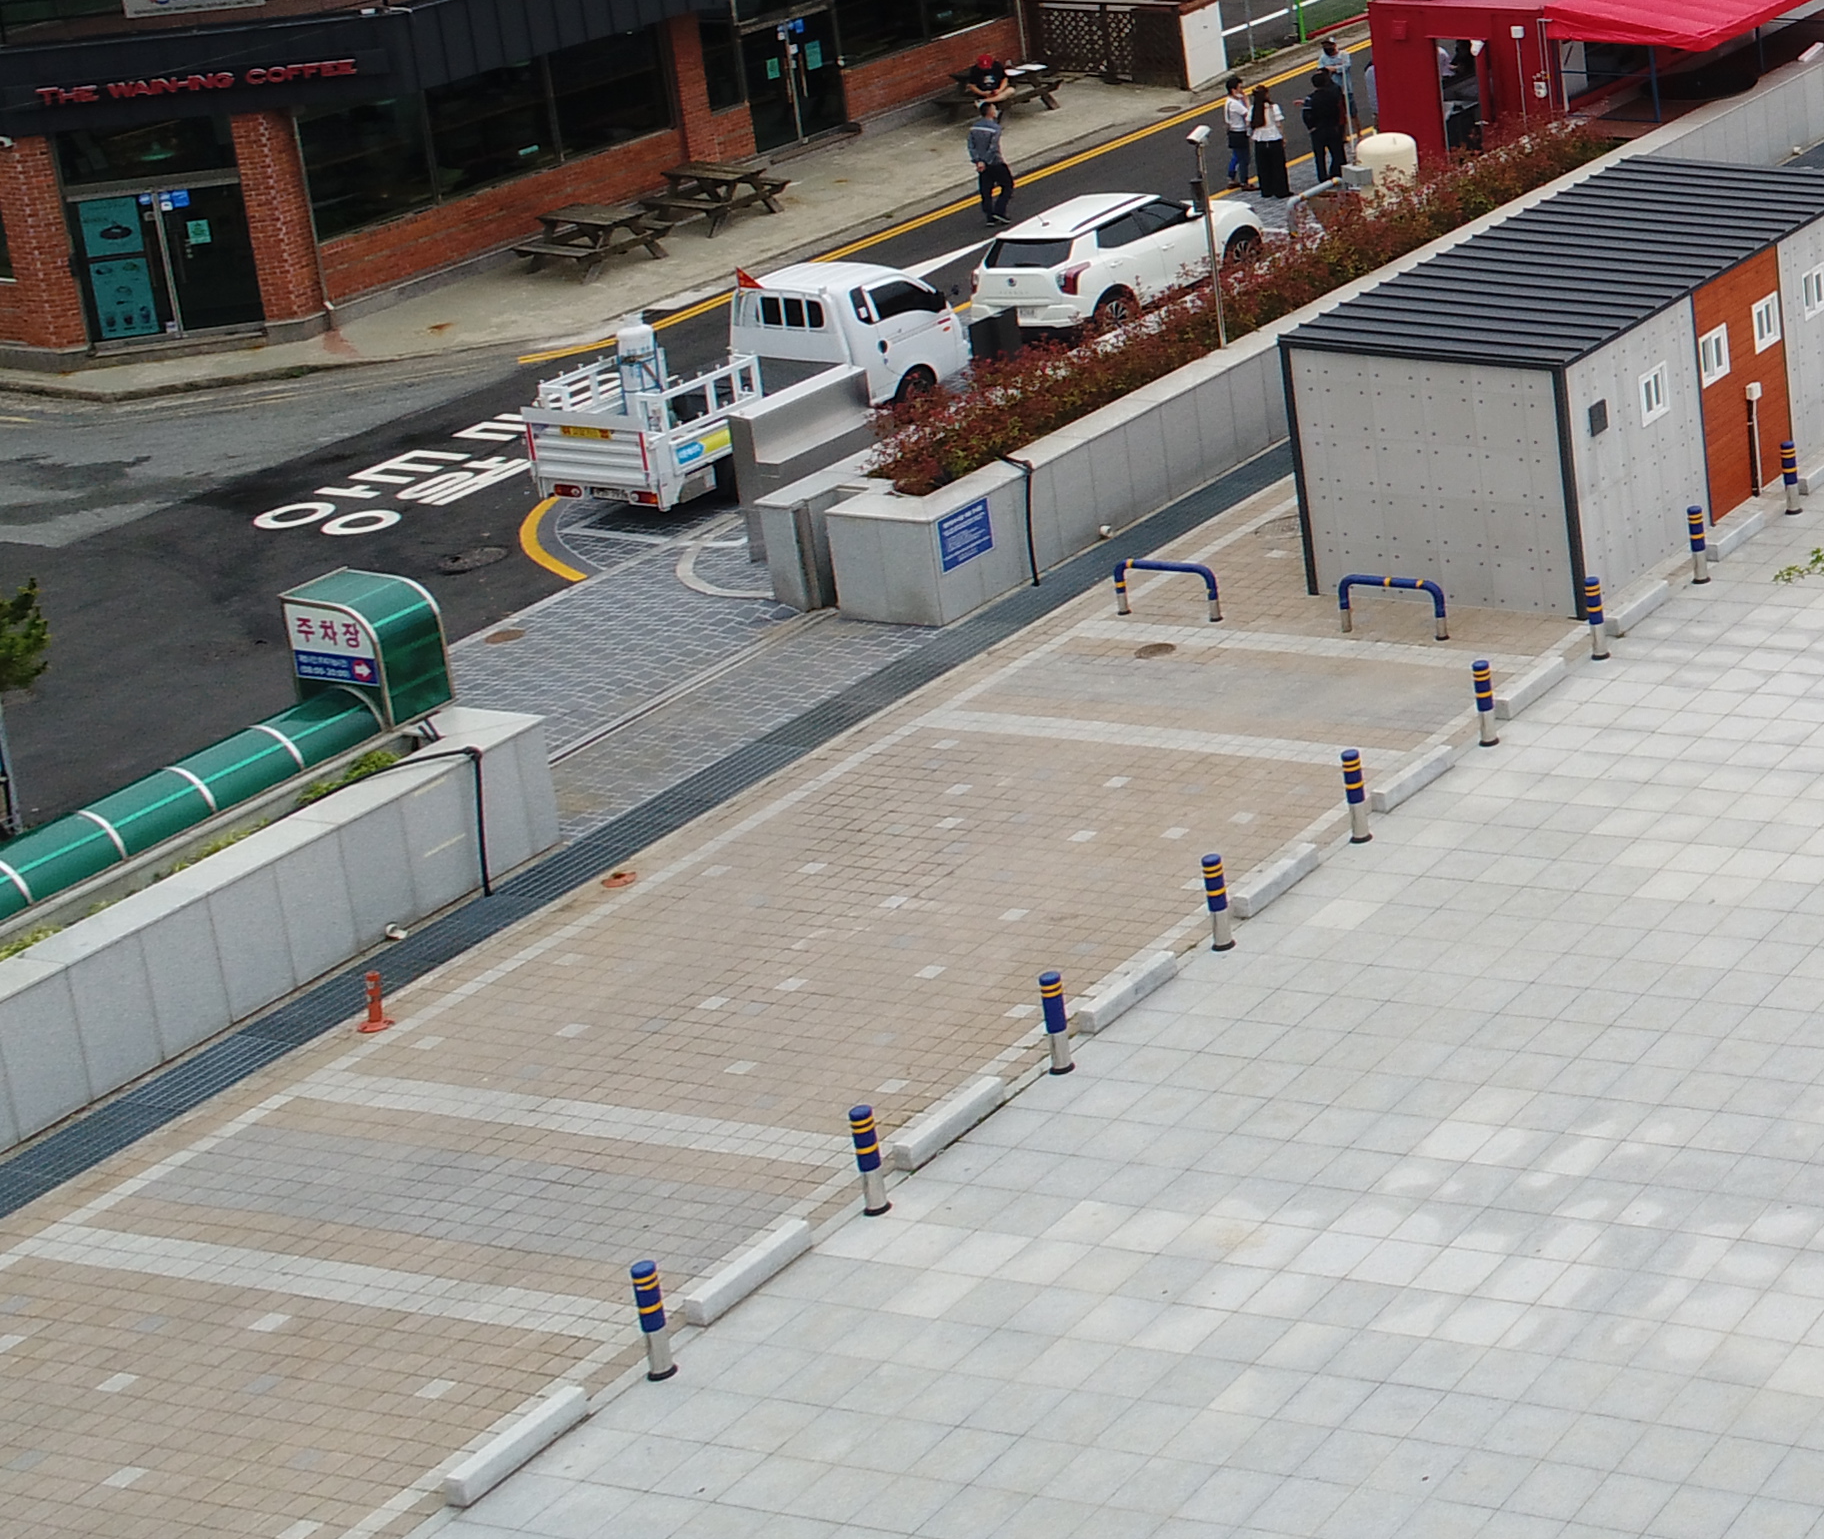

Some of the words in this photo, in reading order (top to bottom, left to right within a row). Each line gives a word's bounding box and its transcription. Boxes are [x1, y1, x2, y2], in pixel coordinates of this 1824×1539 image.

[35, 85, 99, 106] THE
[107, 72, 235, 98] WAIN-ING
[246, 59, 357, 84] COFFEE
[296, 617, 361, 649] 주차장
